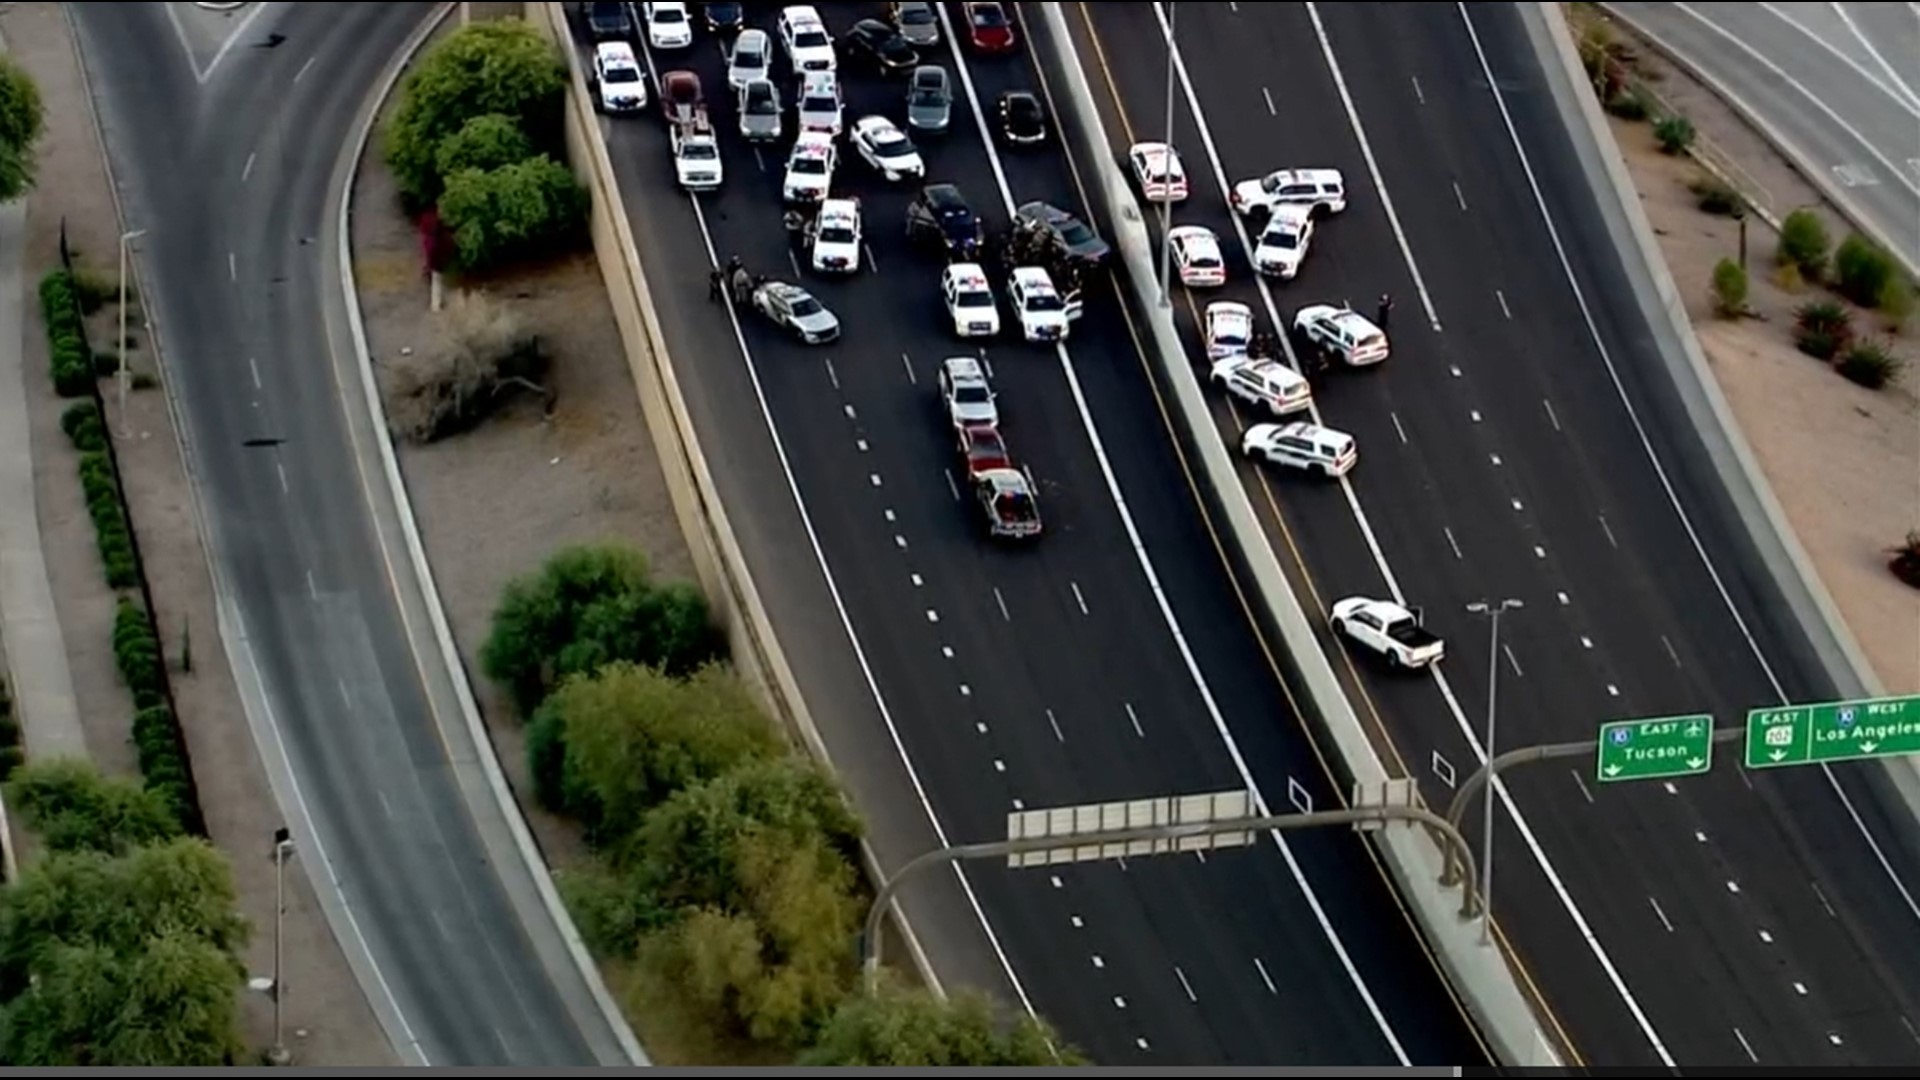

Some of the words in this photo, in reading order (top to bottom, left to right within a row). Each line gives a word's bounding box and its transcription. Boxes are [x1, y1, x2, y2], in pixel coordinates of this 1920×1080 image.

[1867, 702, 1907, 714] WEST
[1761, 711, 1799, 725] EAST
[1640, 722, 1678, 736] EAST
[1768, 729, 1790, 743] 202
[1816, 729, 1847, 741] Los
[1851, 721, 1920, 741] Angeles
[1624, 745, 1688, 761] Tucson
